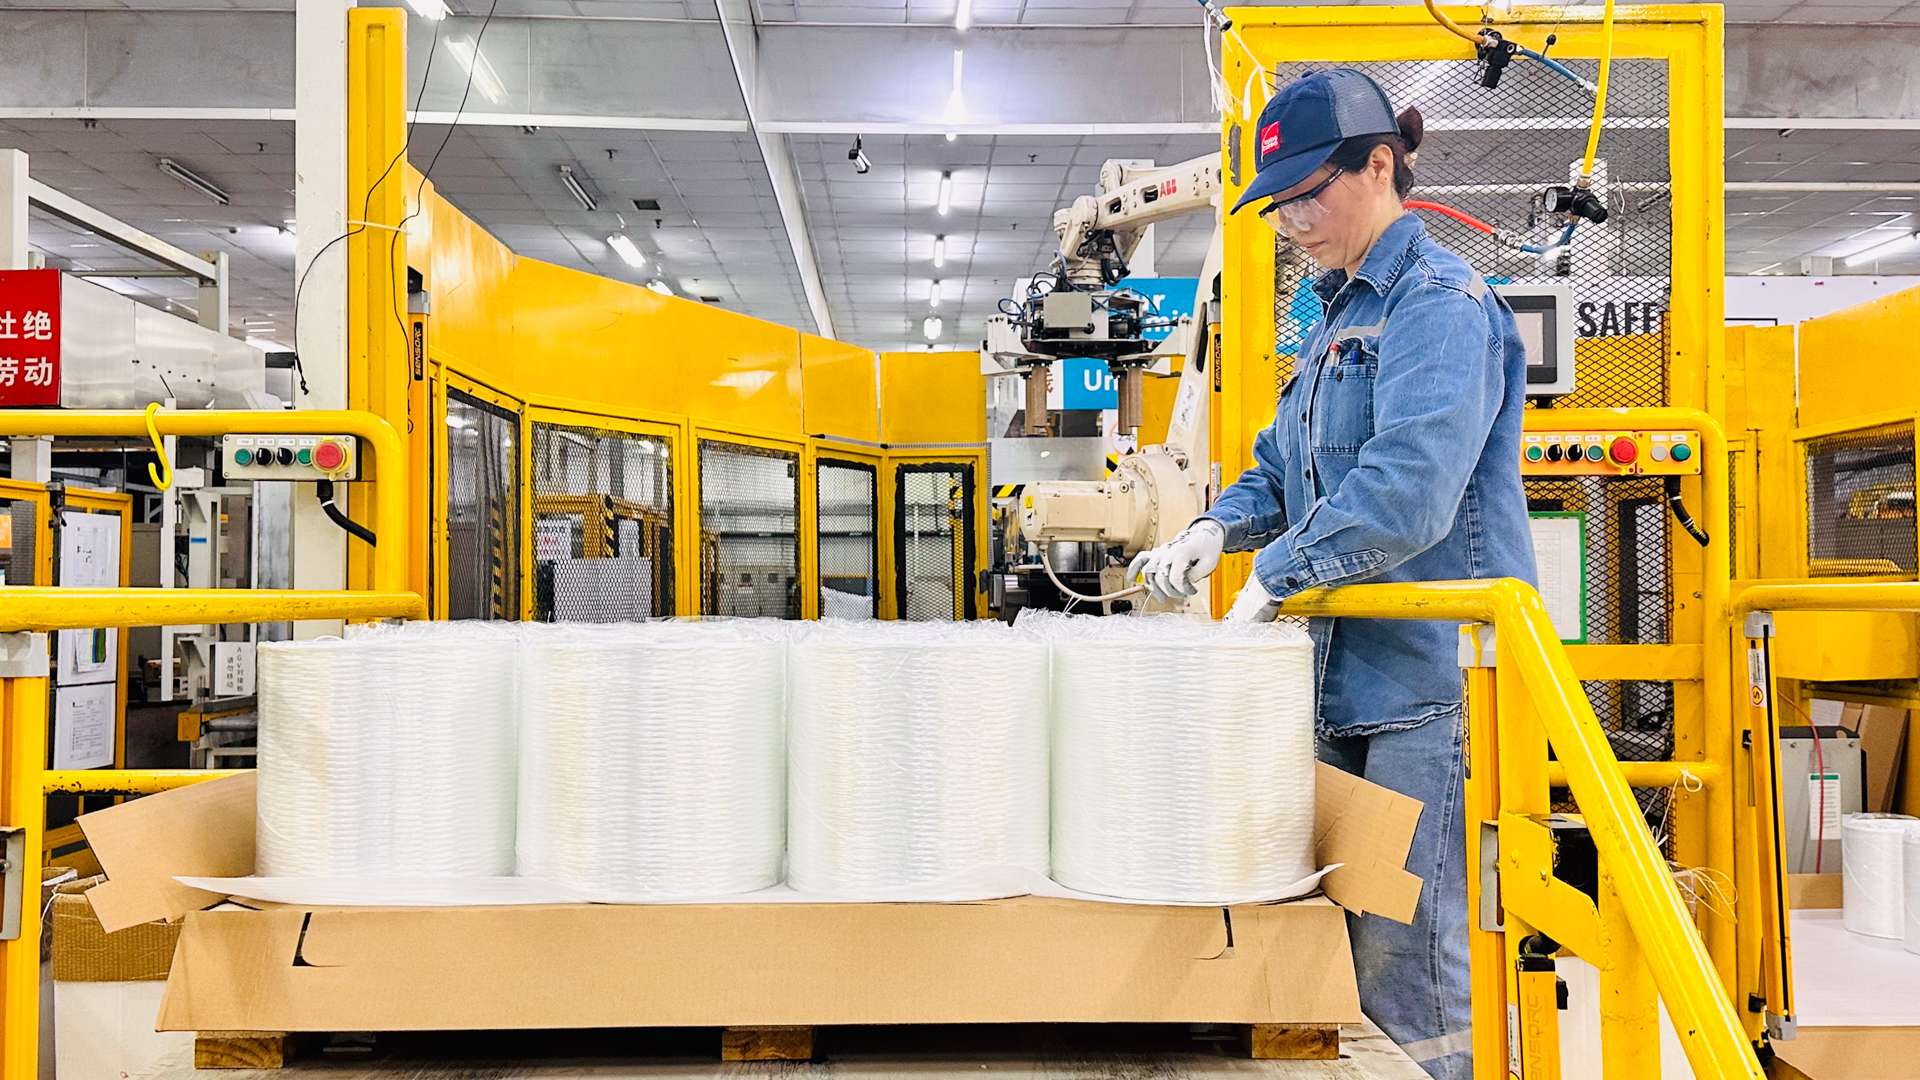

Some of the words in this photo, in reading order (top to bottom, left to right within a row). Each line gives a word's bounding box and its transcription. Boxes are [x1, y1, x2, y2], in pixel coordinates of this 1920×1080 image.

[1160, 178, 1177, 198] ABB
[0, 310, 52, 340] 杜绝
[0, 356, 53, 387] 劳动
